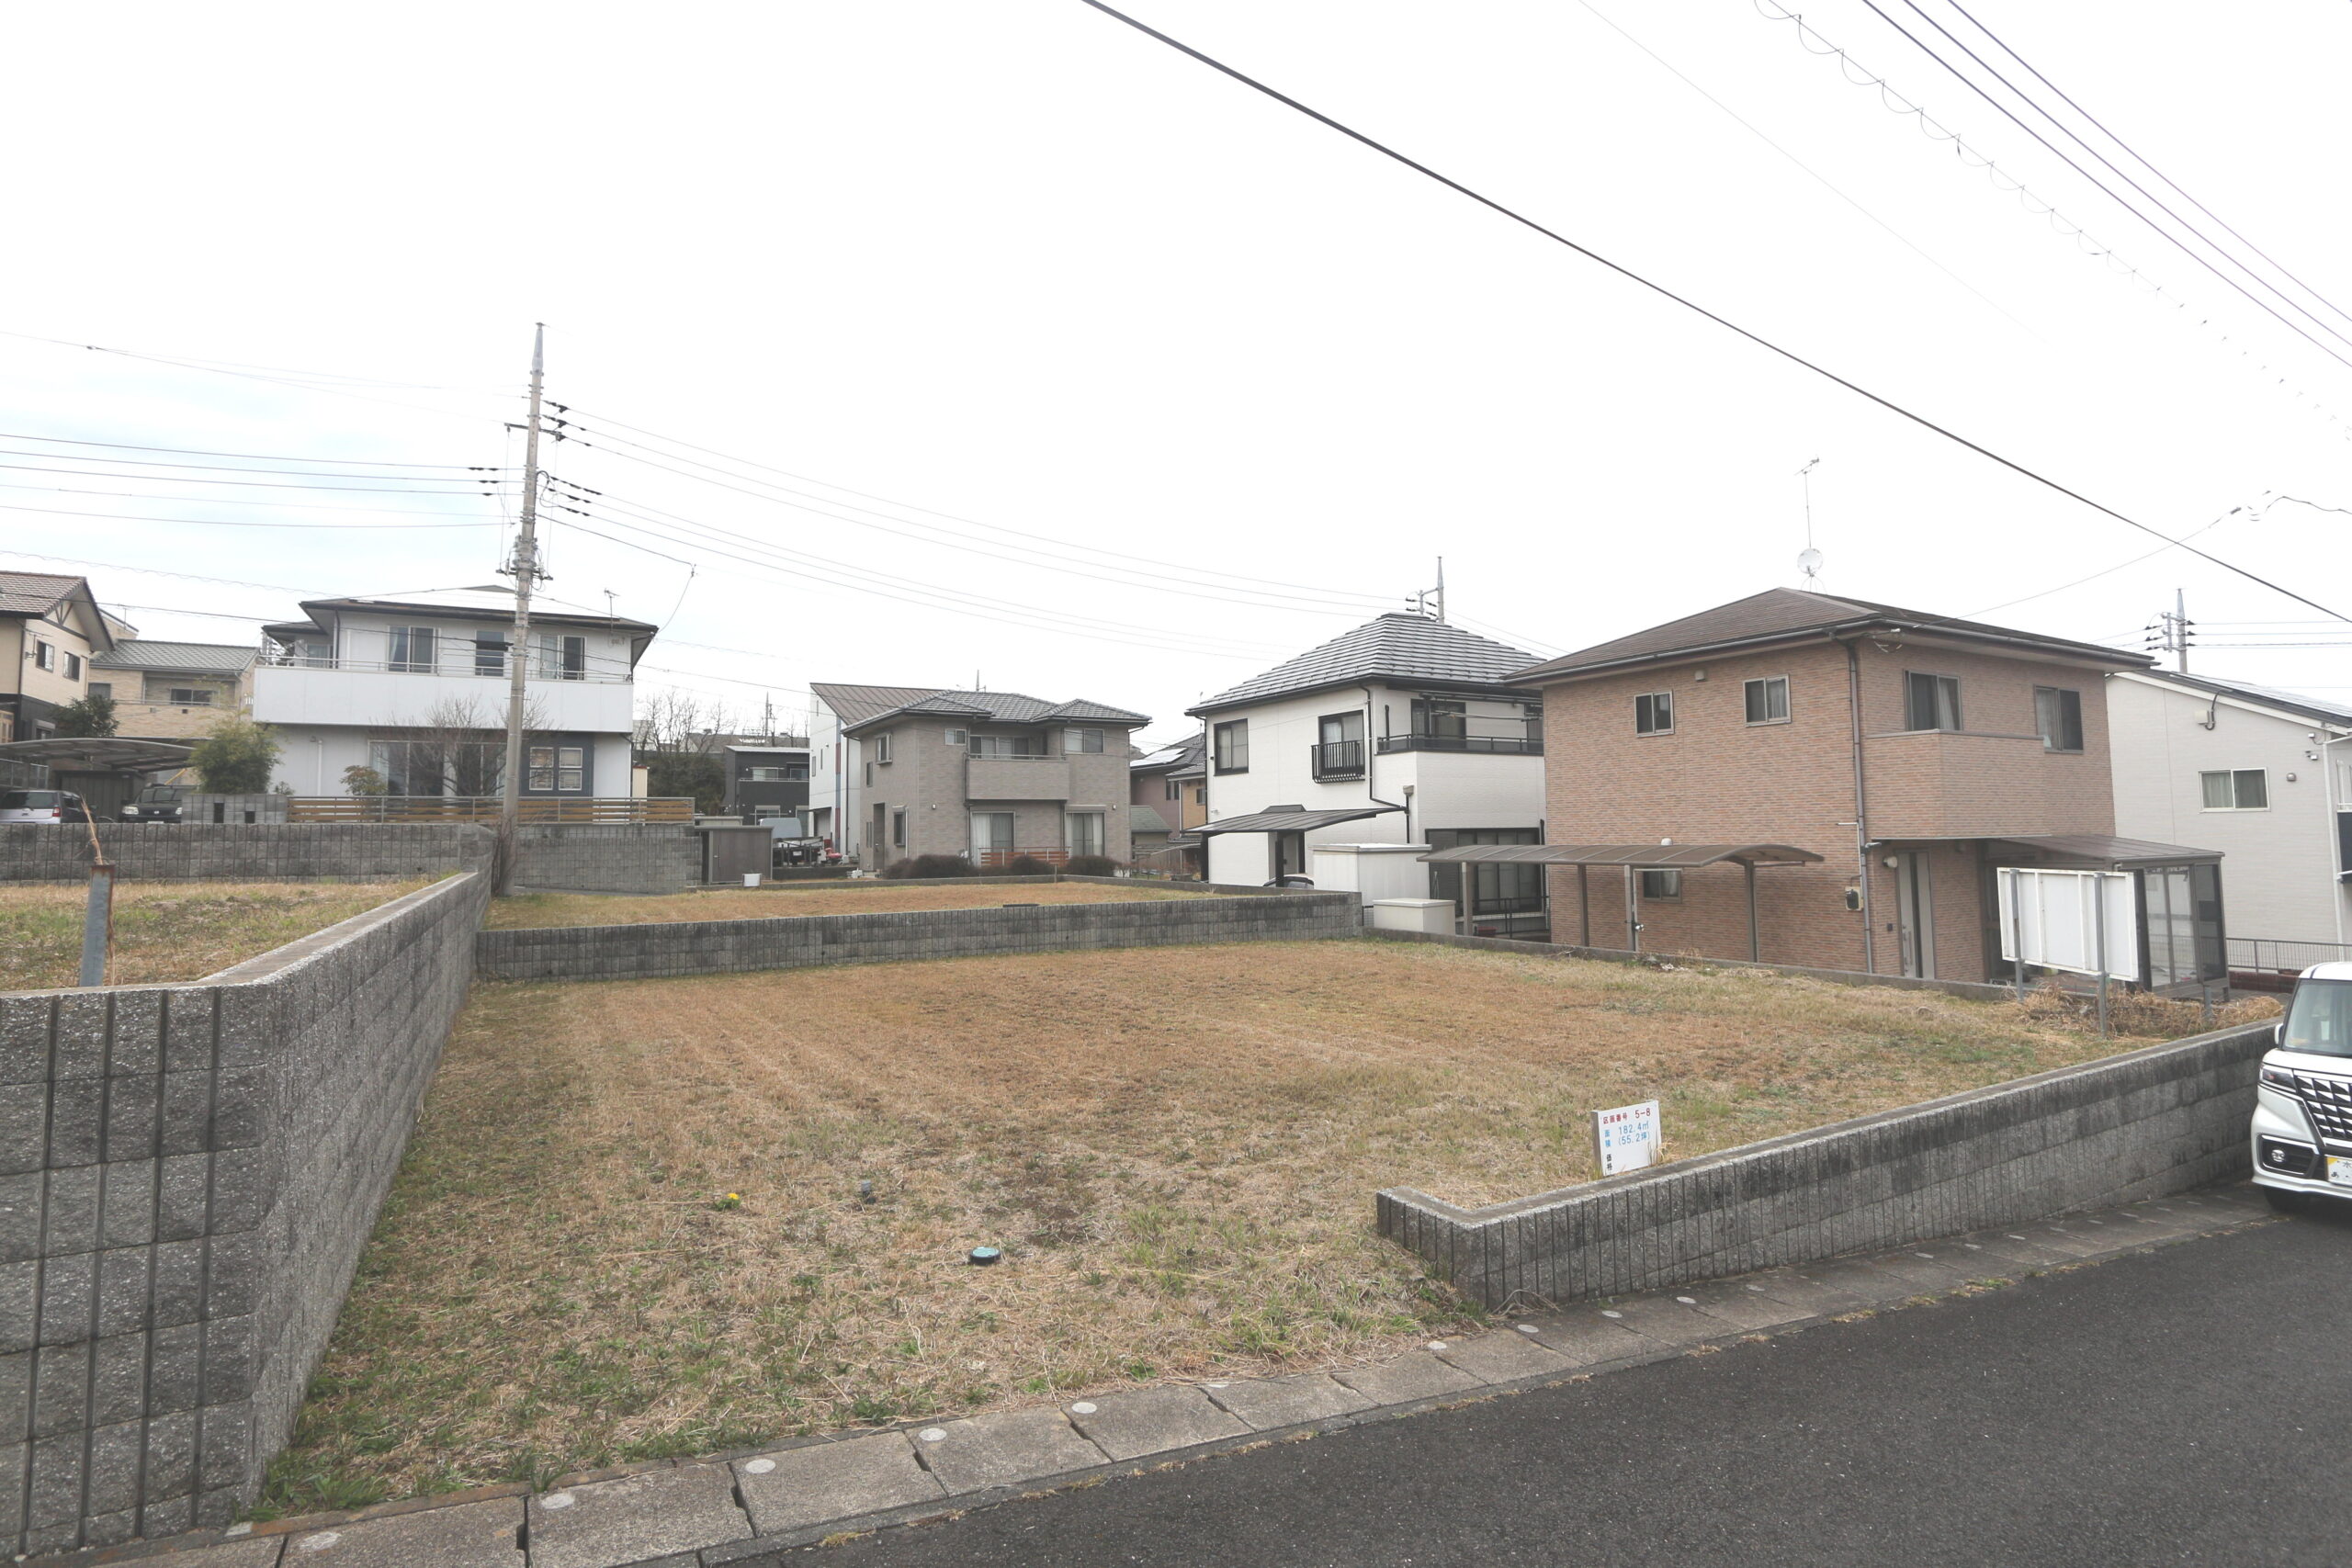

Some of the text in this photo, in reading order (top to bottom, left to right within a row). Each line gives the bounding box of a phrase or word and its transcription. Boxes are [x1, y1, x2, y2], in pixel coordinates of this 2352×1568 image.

[1603, 1108, 1651, 1124] 区画番号 5-8
